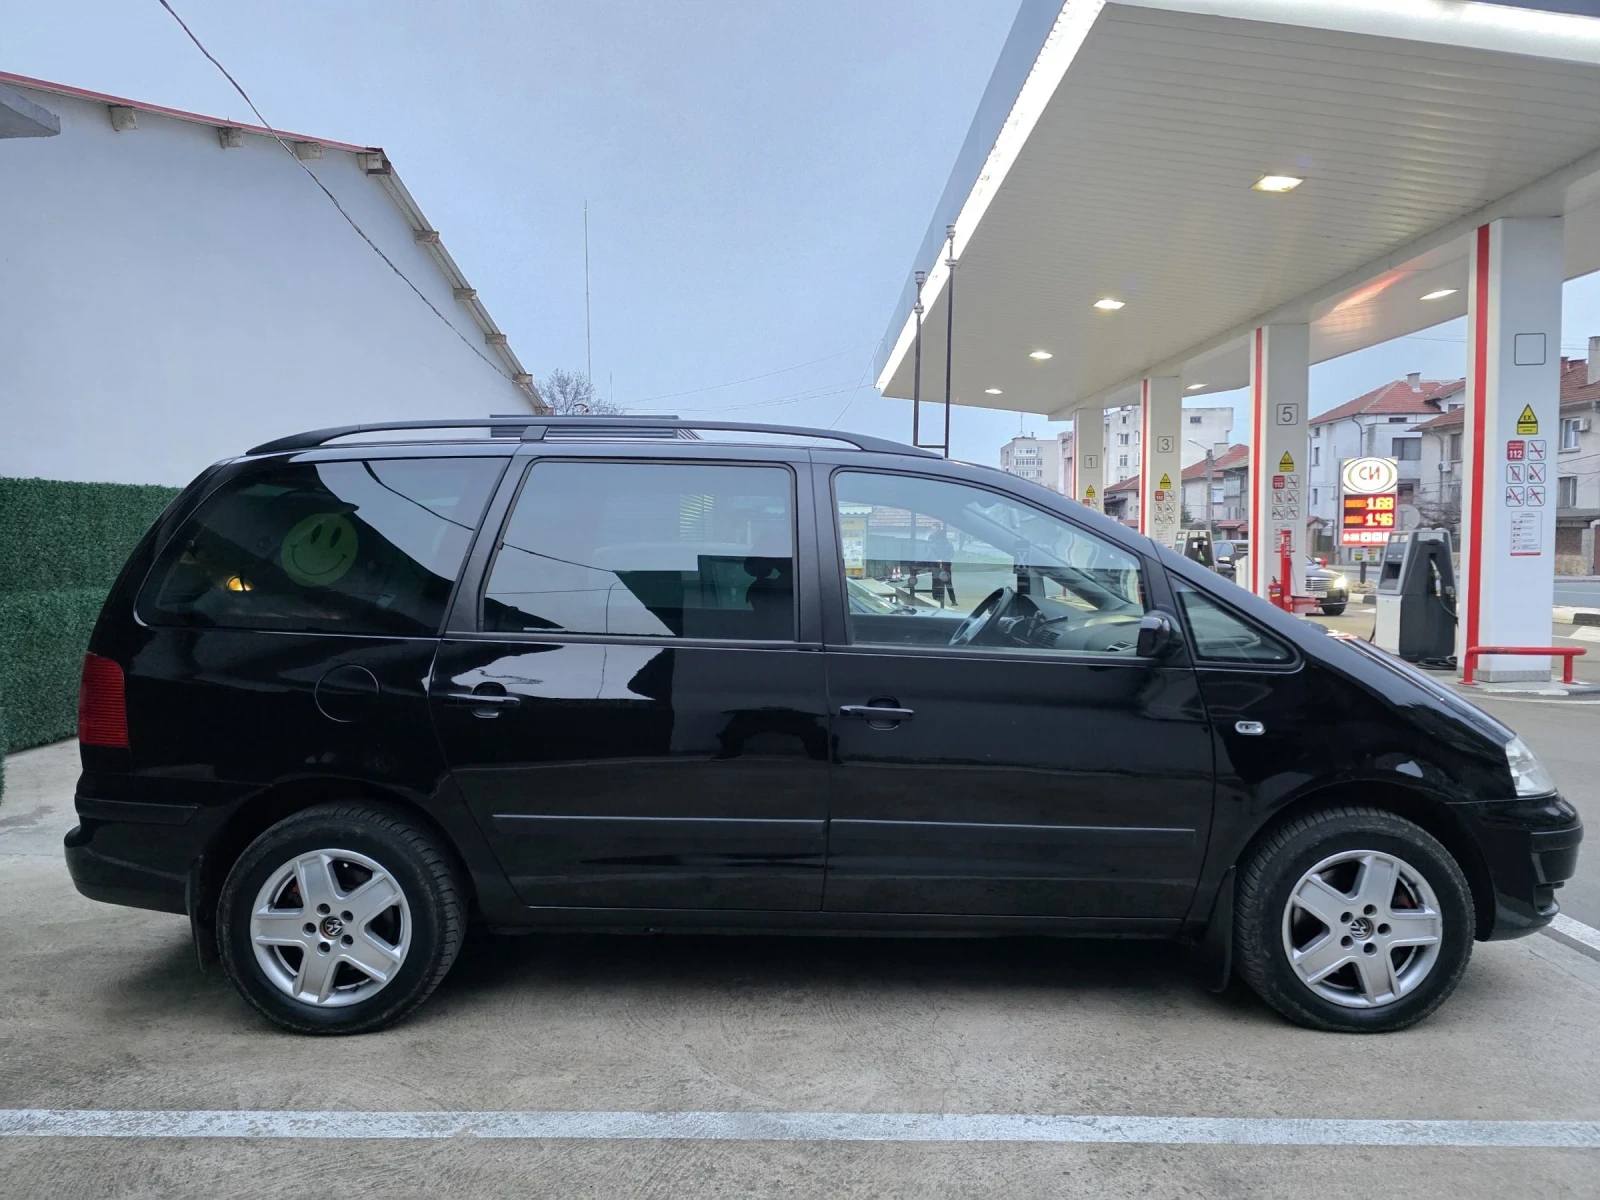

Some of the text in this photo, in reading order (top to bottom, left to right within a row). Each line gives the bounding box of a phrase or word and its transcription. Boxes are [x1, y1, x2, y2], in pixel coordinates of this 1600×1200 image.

[1282, 406, 1293, 423] 5
[1161, 438, 1170, 451] 3
[1508, 450, 1523, 459] 112
[1087, 457, 1093, 467] 1
